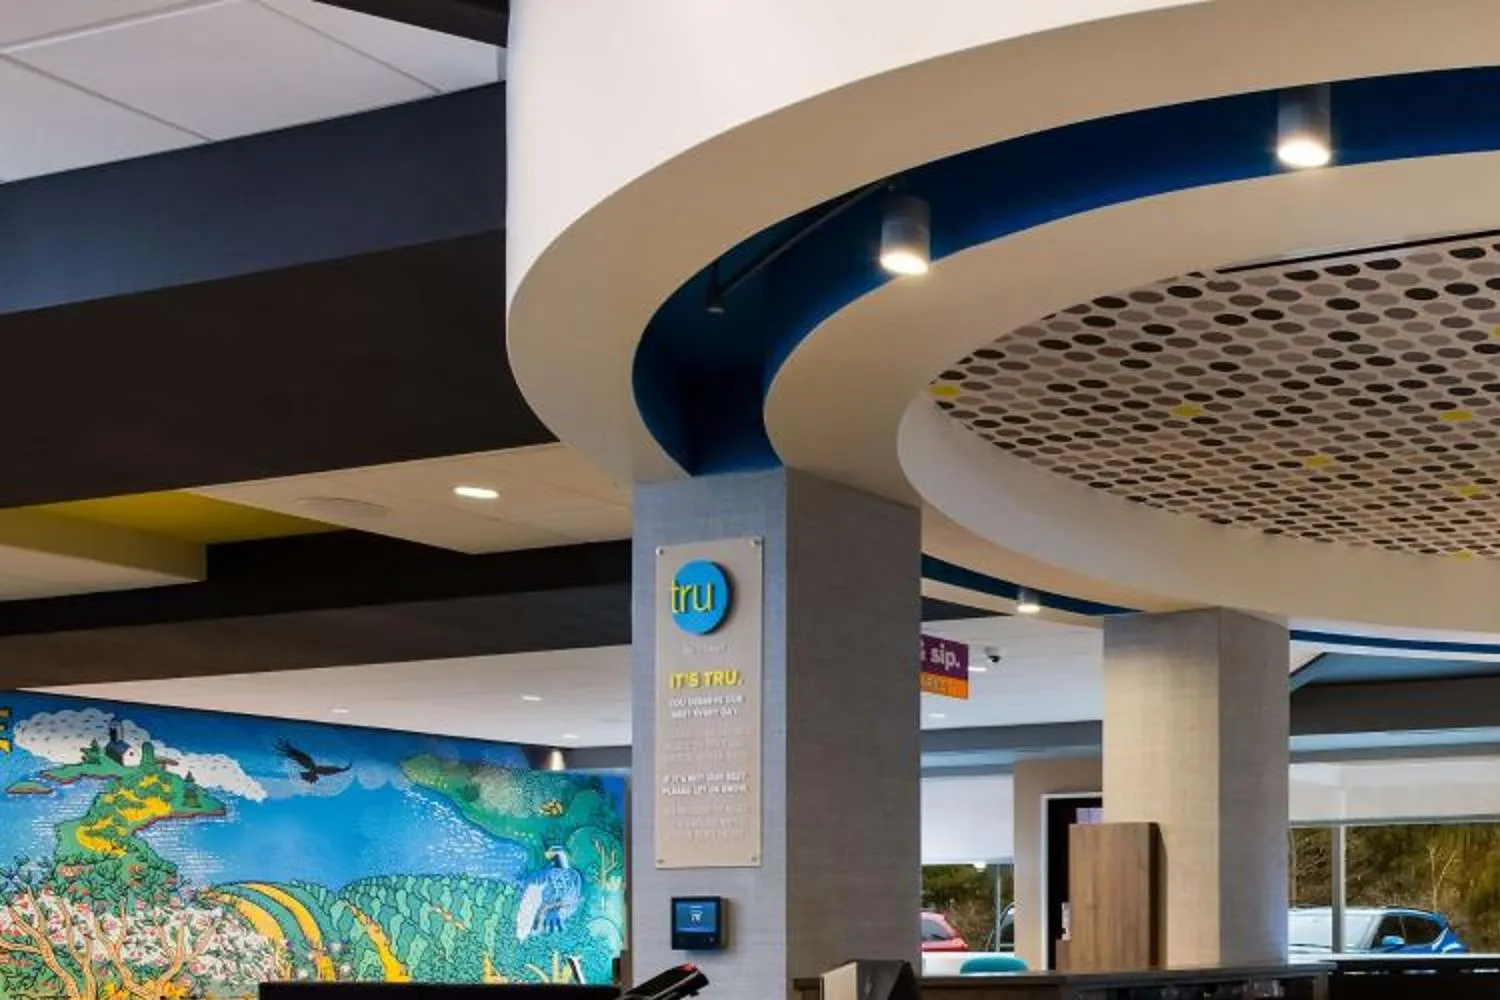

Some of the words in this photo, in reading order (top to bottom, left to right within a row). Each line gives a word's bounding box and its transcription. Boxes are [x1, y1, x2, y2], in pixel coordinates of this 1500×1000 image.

[671, 580, 715, 613] tru
[930, 643, 961, 671] sip.
[670, 671, 700, 689] IT'S
